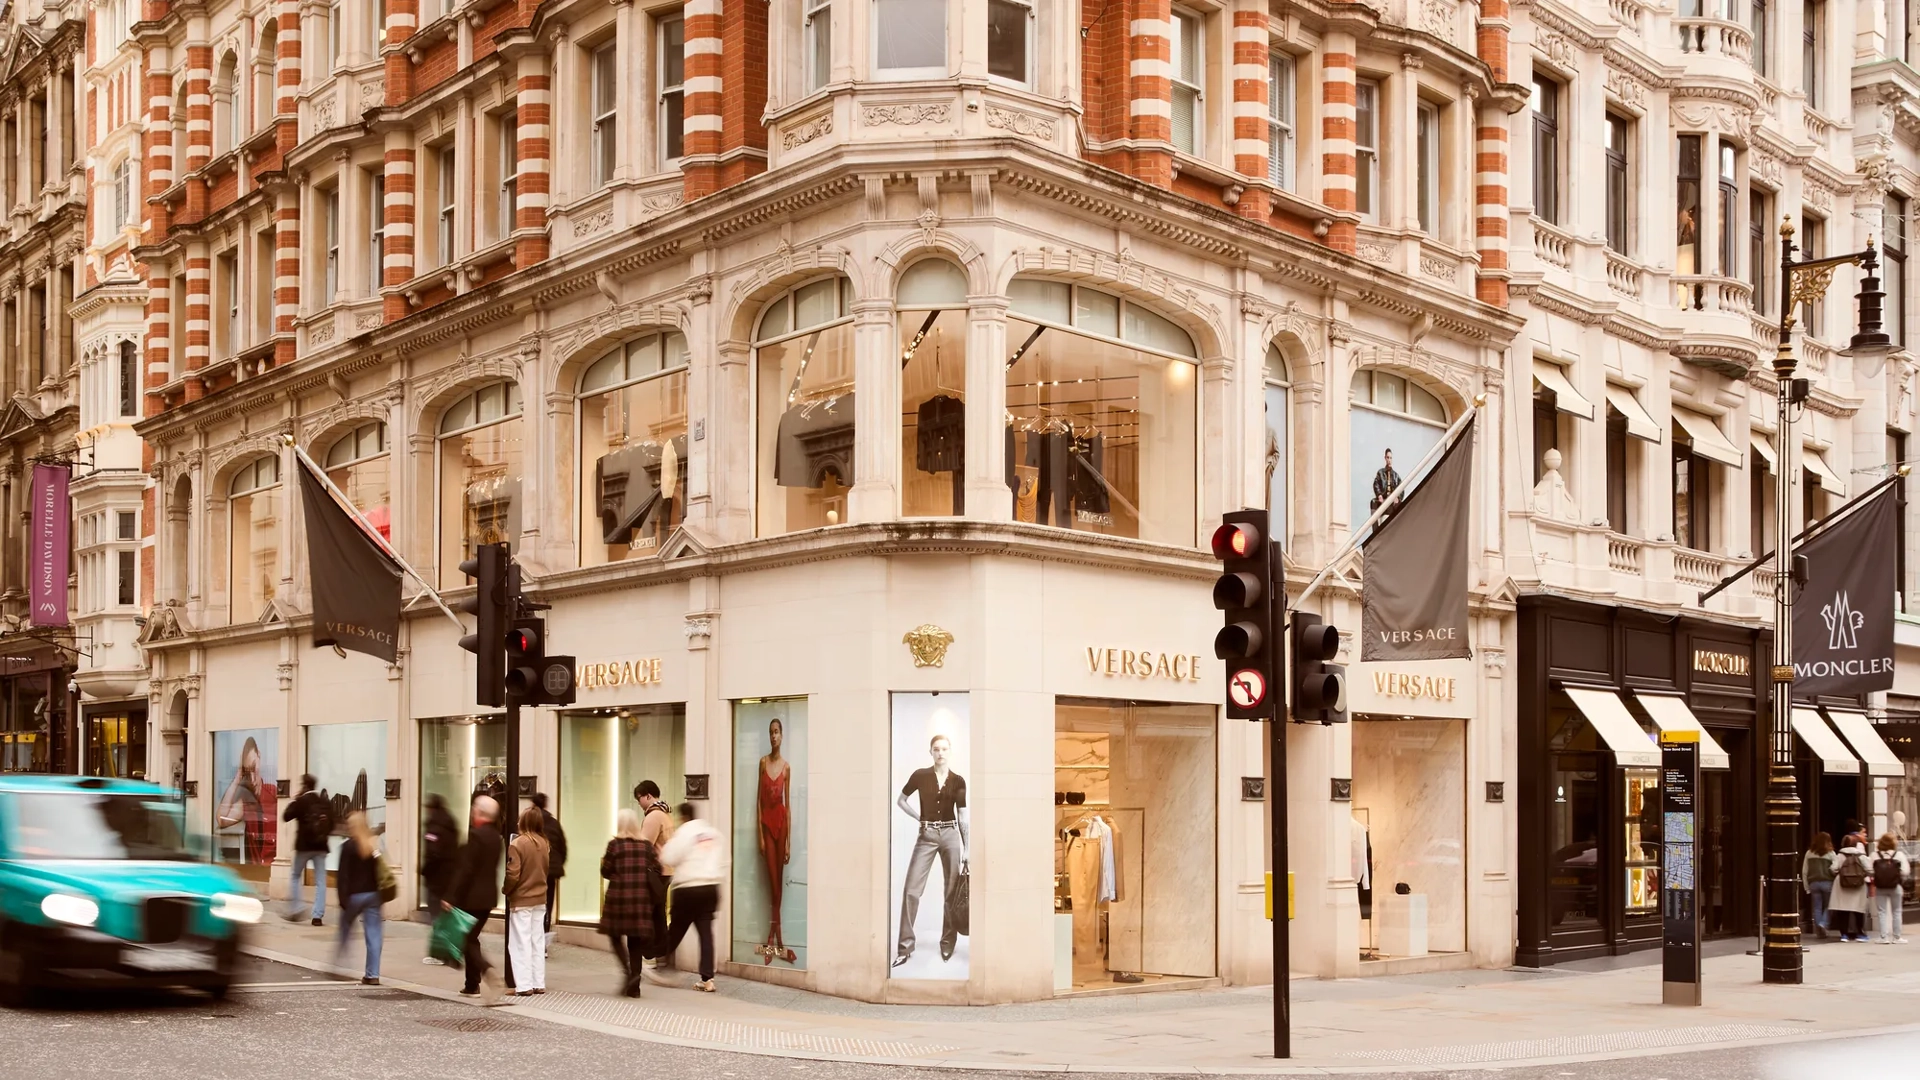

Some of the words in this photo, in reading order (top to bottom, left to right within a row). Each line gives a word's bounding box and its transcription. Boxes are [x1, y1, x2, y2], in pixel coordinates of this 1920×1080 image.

[44, 483, 55, 537] MORELLE
[43, 541, 53, 596] DAVIDSON
[325, 620, 393, 646] VERSACE
[1380, 627, 1457, 644] VERSACE
[575, 657, 662, 689] VERSACE
[1085, 646, 1202, 682] VERSACE
[1694, 650, 1751, 676] MONCLER
[1794, 657, 1894, 678] MONCLER
[1372, 671, 1457, 700] VERSACE
